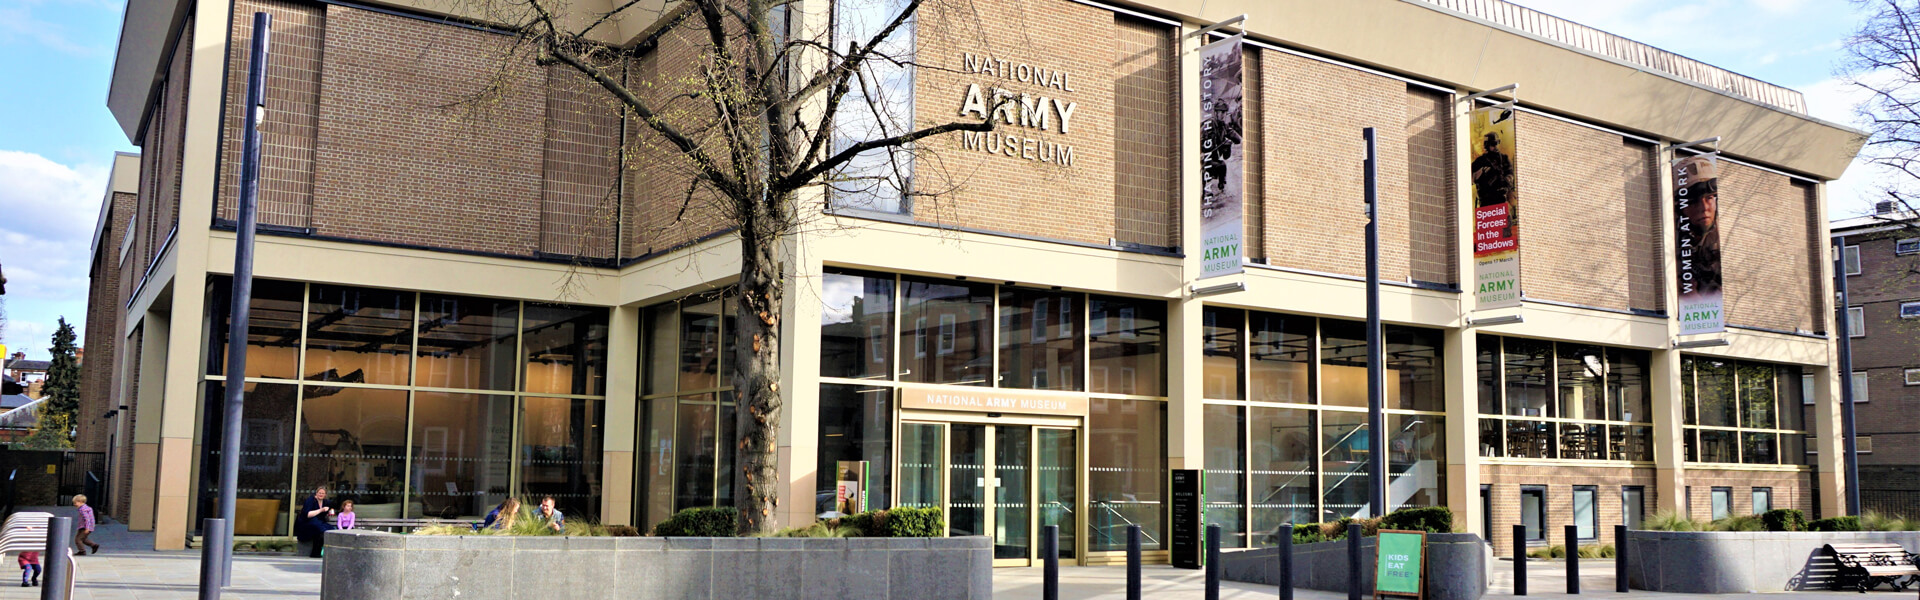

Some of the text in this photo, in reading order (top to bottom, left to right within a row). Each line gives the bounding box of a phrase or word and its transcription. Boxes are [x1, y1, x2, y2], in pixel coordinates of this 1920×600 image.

[964, 52, 1074, 92] NATIONAL
[961, 83, 1077, 133] ARMY
[1203, 57, 1213, 218] SHAPING HISTORY
[963, 130, 1073, 166] MUSEUM
[1476, 206, 1506, 220] Special
[1477, 218, 1506, 230] Forces:
[1677, 166, 1693, 294] WOMEN AT WORK
[1203, 233, 1238, 246] NATIONAL
[1477, 230, 1500, 241] In the
[1477, 239, 1514, 251] Shadows
[1203, 243, 1239, 261] ARMY
[1203, 259, 1238, 272] MUSEUM
[1479, 270, 1515, 280] NATIONAL
[1479, 279, 1515, 294] ARMY
[1480, 292, 1516, 303] MUSEUM
[1684, 302, 1719, 310] NATIONAL
[1684, 310, 1720, 322] ARMY
[1684, 321, 1720, 331] MUSEUM
[927, 394, 1067, 410] NATIONAL ARMY MUSEUM
[1388, 554, 1409, 562] KIDS
